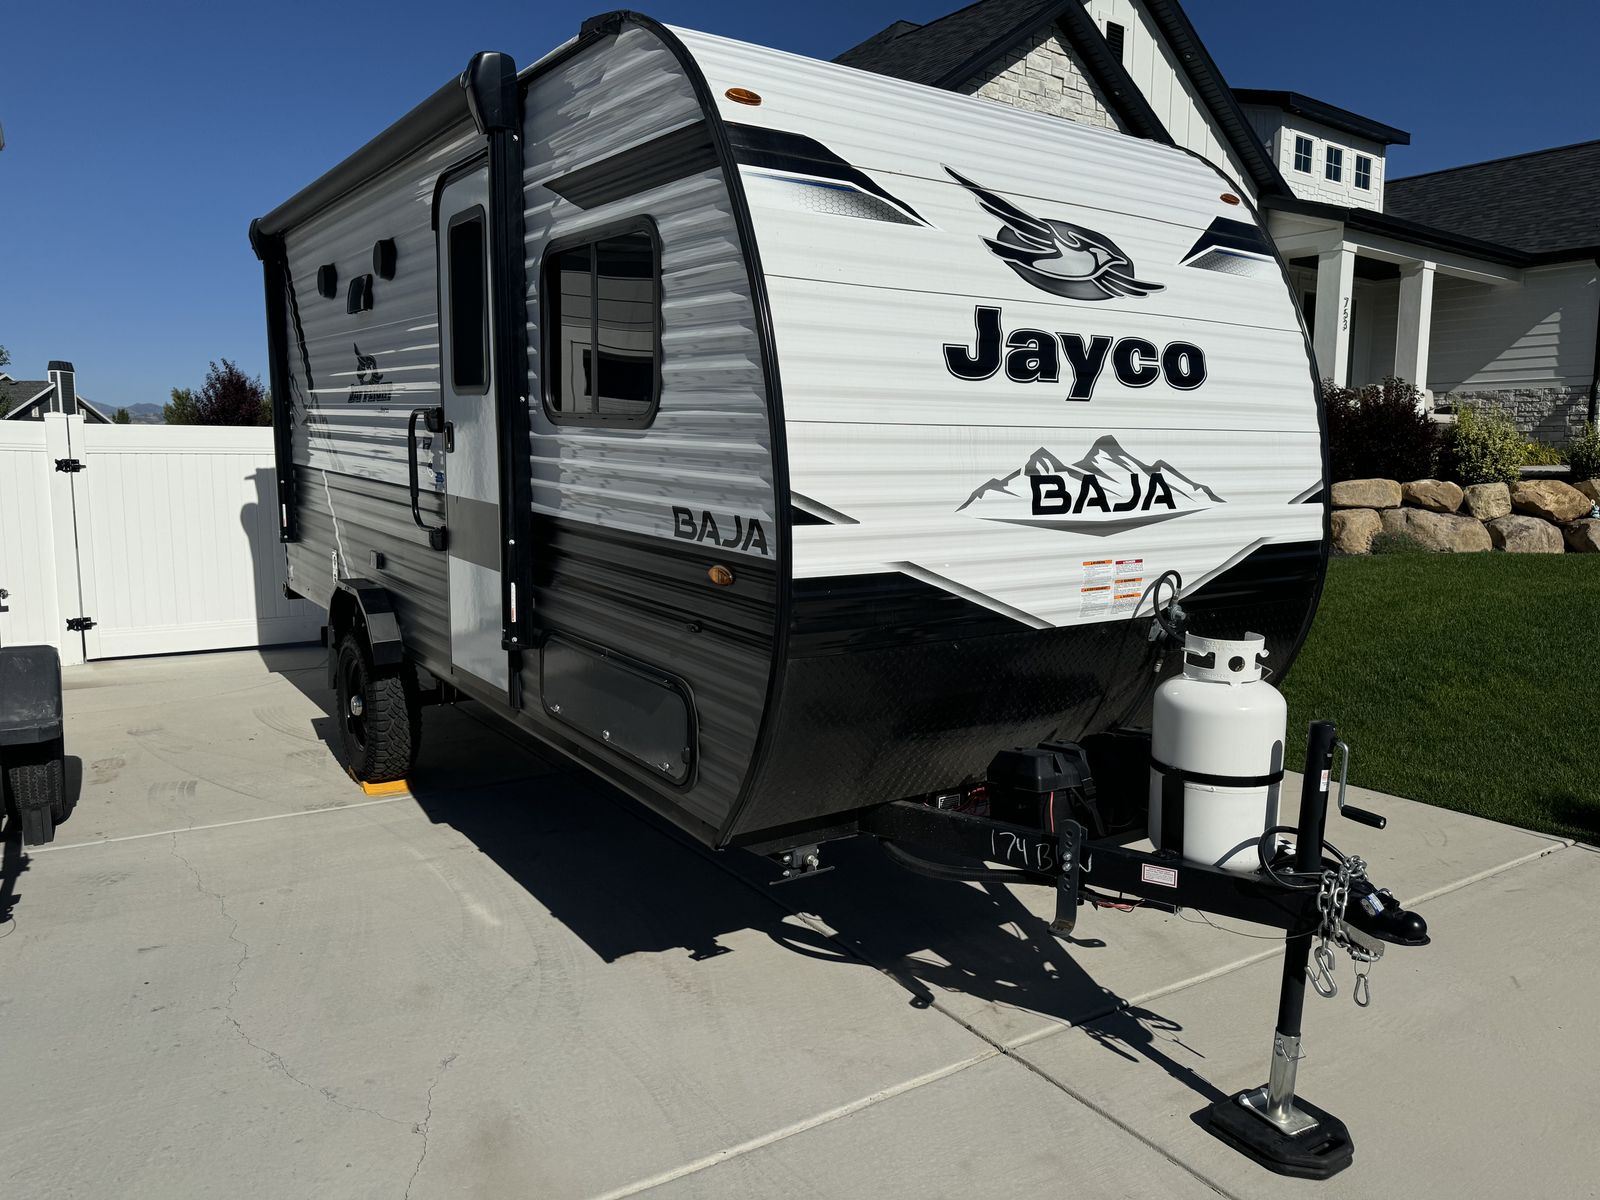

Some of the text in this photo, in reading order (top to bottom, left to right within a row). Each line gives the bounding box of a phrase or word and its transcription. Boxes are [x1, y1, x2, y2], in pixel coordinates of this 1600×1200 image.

[942, 305, 1207, 401] Jayco
[1030, 473, 1176, 515] BAJA
[672, 505, 768, 555] BAJA
[991, 829, 1028, 865] 174
